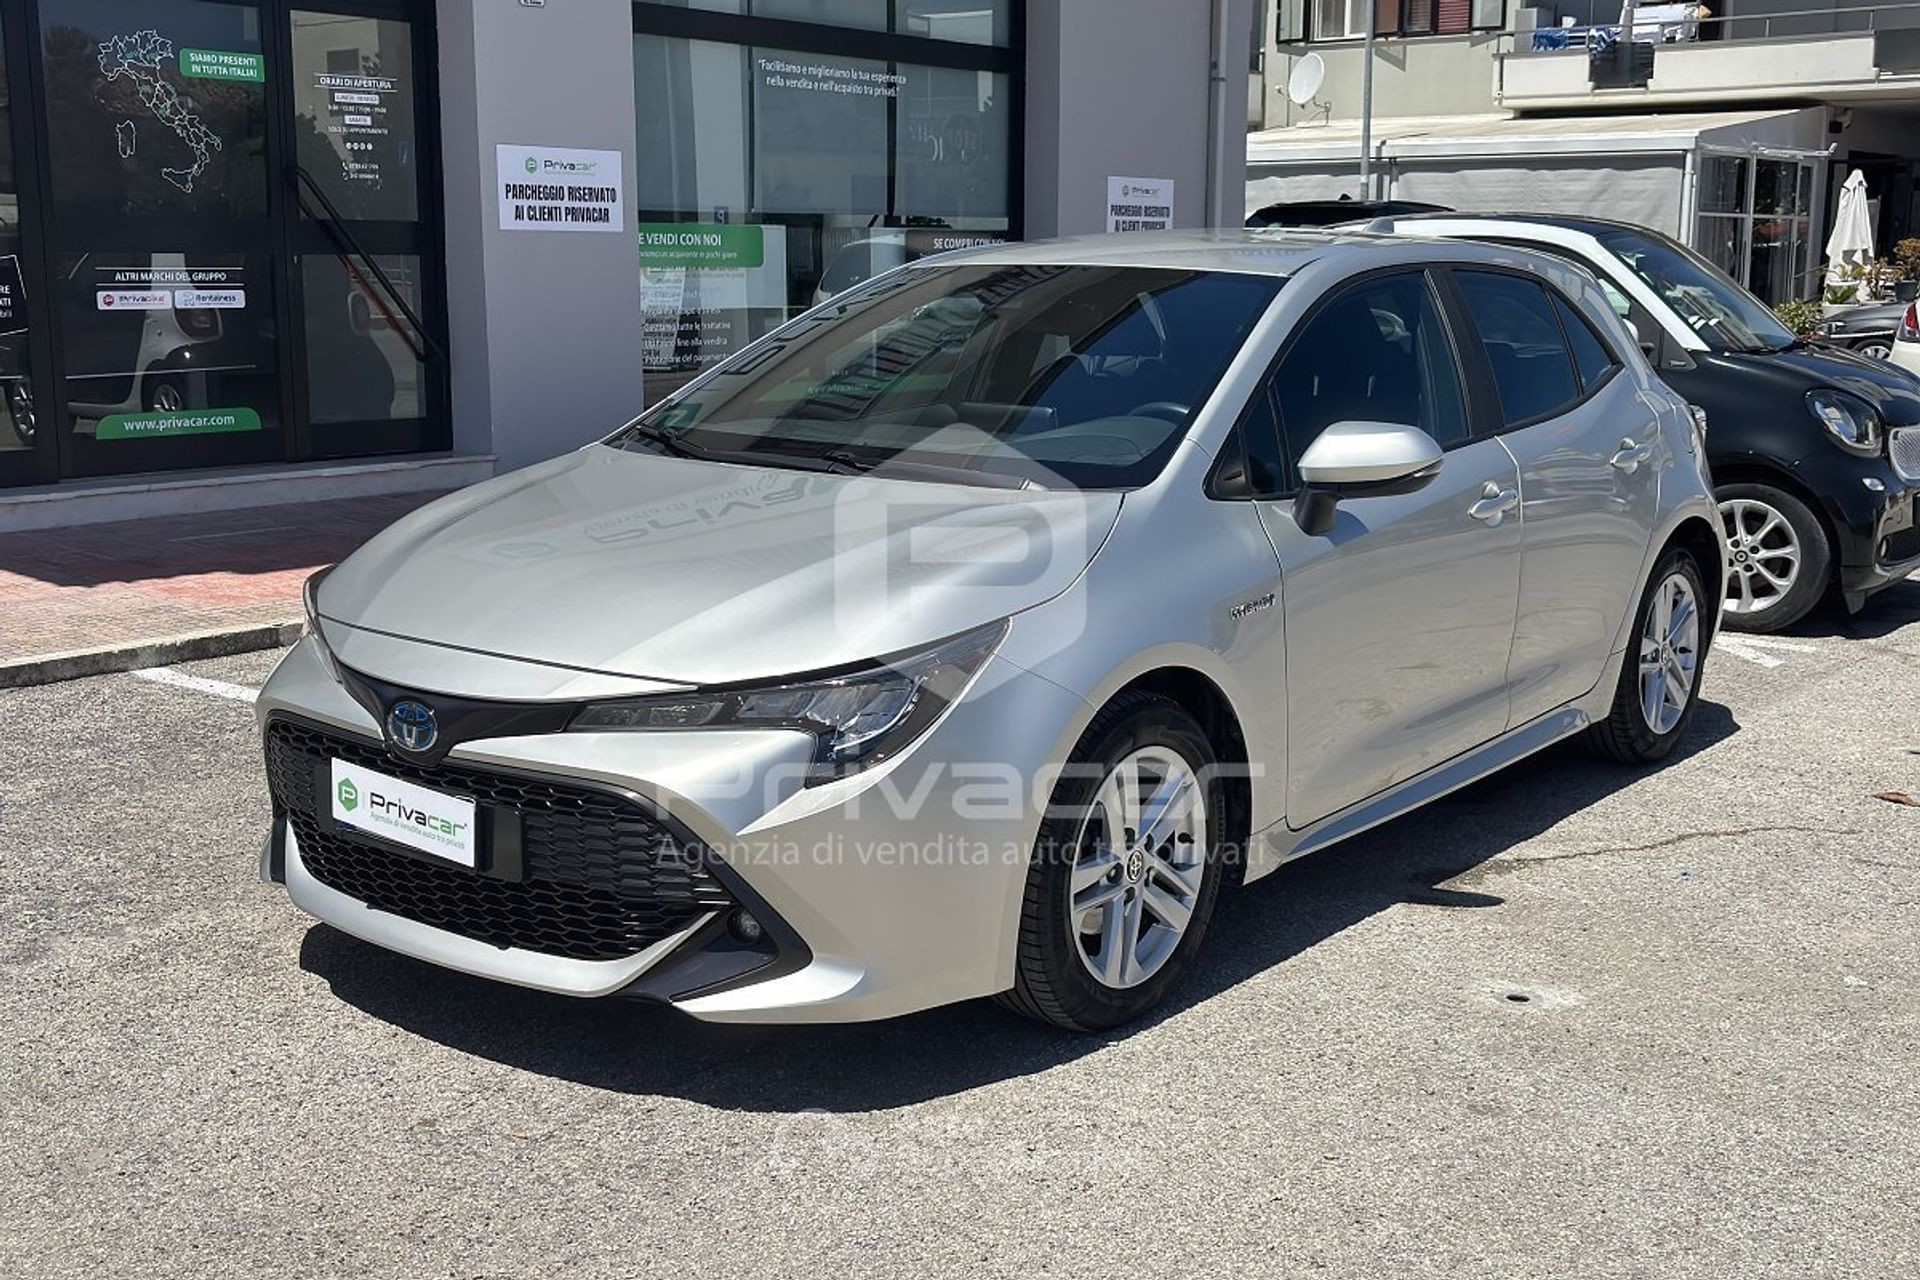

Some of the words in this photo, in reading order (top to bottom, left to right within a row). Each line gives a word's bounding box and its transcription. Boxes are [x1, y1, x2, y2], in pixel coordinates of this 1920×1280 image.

[189, 53, 217, 63] SIAMO
[218, 55, 257, 67] PRESENTI
[191, 64, 201, 73] IN
[202, 65, 228, 76] TUTTA
[319, 77, 344, 87] ORARI
[353, 79, 392, 90] APERTURA
[785, 78, 813, 89] vendita
[543, 160, 597, 171] Privacar
[505, 184, 565, 201] PARCHEGGIO
[567, 186, 617, 203] RISERVATO
[514, 205, 525, 221] AI
[526, 205, 562, 222] CLIENTI
[564, 207, 610, 223] PRIVACAR
[646, 233, 679, 245] VENDI
[680, 233, 701, 245] CON
[703, 234, 722, 246] NOI
[933, 238, 944, 249] SE
[944, 238, 975, 249] COMPRI
[115, 271, 139, 281] ALTRI
[140, 271, 174, 281] MARCHI
[175, 271, 191, 281] DEL
[192, 271, 227, 281] GRUPPO
[123, 415, 236, 431] www.privacar.com
[370, 792, 465, 836] Privacar
